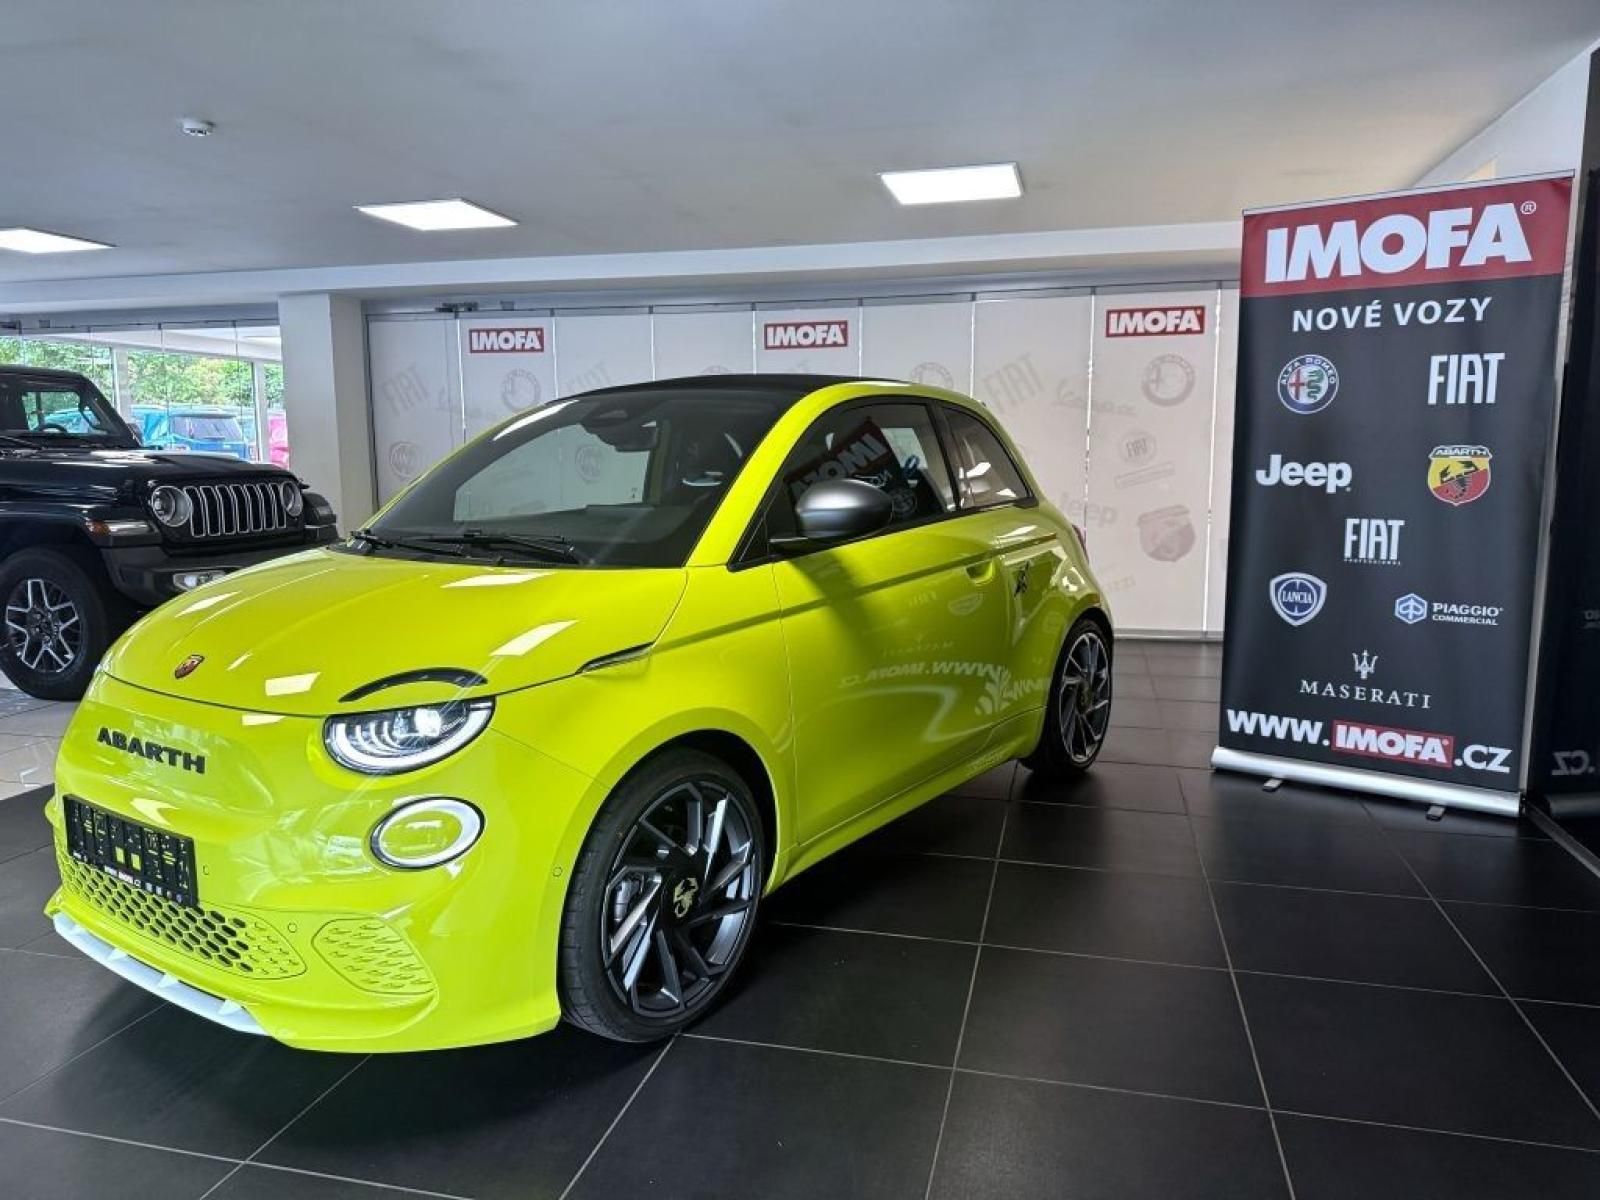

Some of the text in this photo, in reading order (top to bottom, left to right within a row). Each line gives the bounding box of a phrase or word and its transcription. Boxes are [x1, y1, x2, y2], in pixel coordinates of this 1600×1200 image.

[1108, 310, 1201, 334] IMOFA
[1292, 297, 1492, 332] NOVÉ VOZY
[471, 330, 542, 350] IMOFA
[766, 324, 845, 346] IMOFA
[1427, 352, 1506, 405] FIAT
[1255, 454, 1353, 493] Jeep
[1344, 518, 1405, 560] FIAT
[1432, 614, 1499, 626] COMMERCIAL
[1300, 680, 1432, 709] MASERATI
[97, 727, 206, 774] ABARTH
